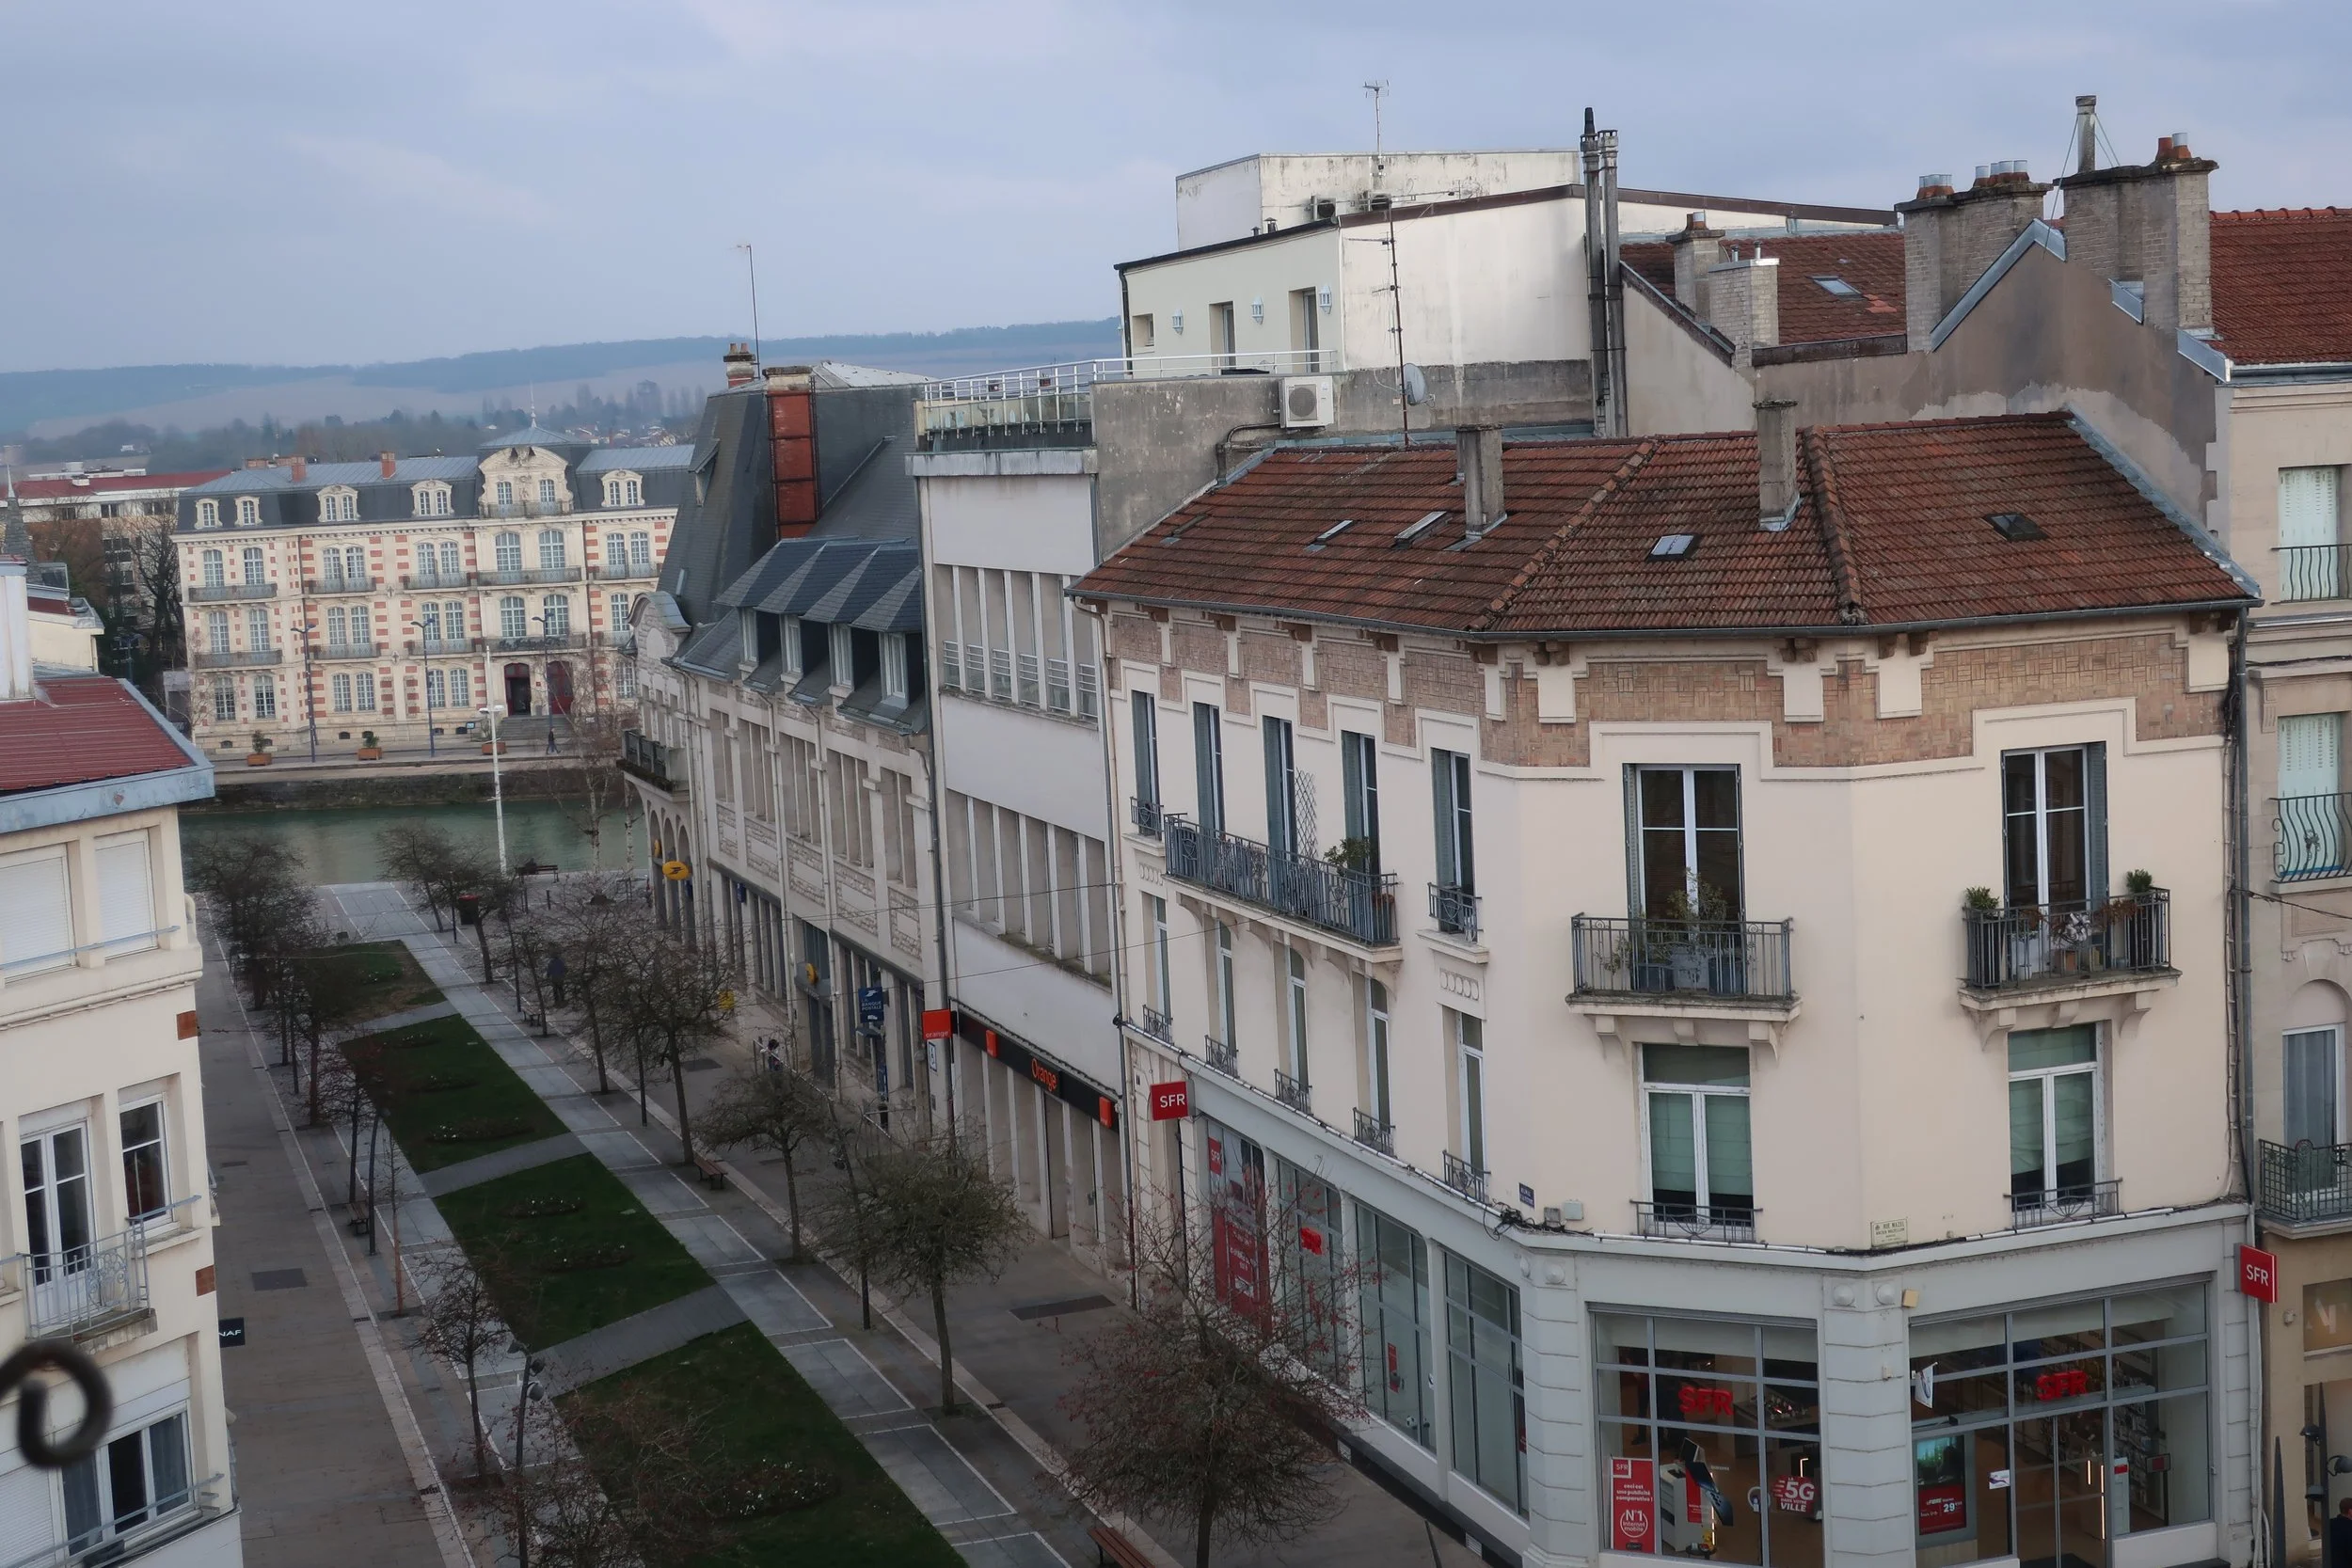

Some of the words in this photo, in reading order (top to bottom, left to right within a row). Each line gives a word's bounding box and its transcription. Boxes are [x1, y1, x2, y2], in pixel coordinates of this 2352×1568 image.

[1031, 1057, 1058, 1092] Orange
[1159, 1093, 1185, 1108] SFR
[2246, 1264, 2269, 1287] SFR
[2036, 1370, 2087, 1400] SFR
[1678, 1386, 1734, 1415] SFR
[1785, 1481, 1815, 1500] 5G
[1780, 1502, 1806, 1513] VILLE
